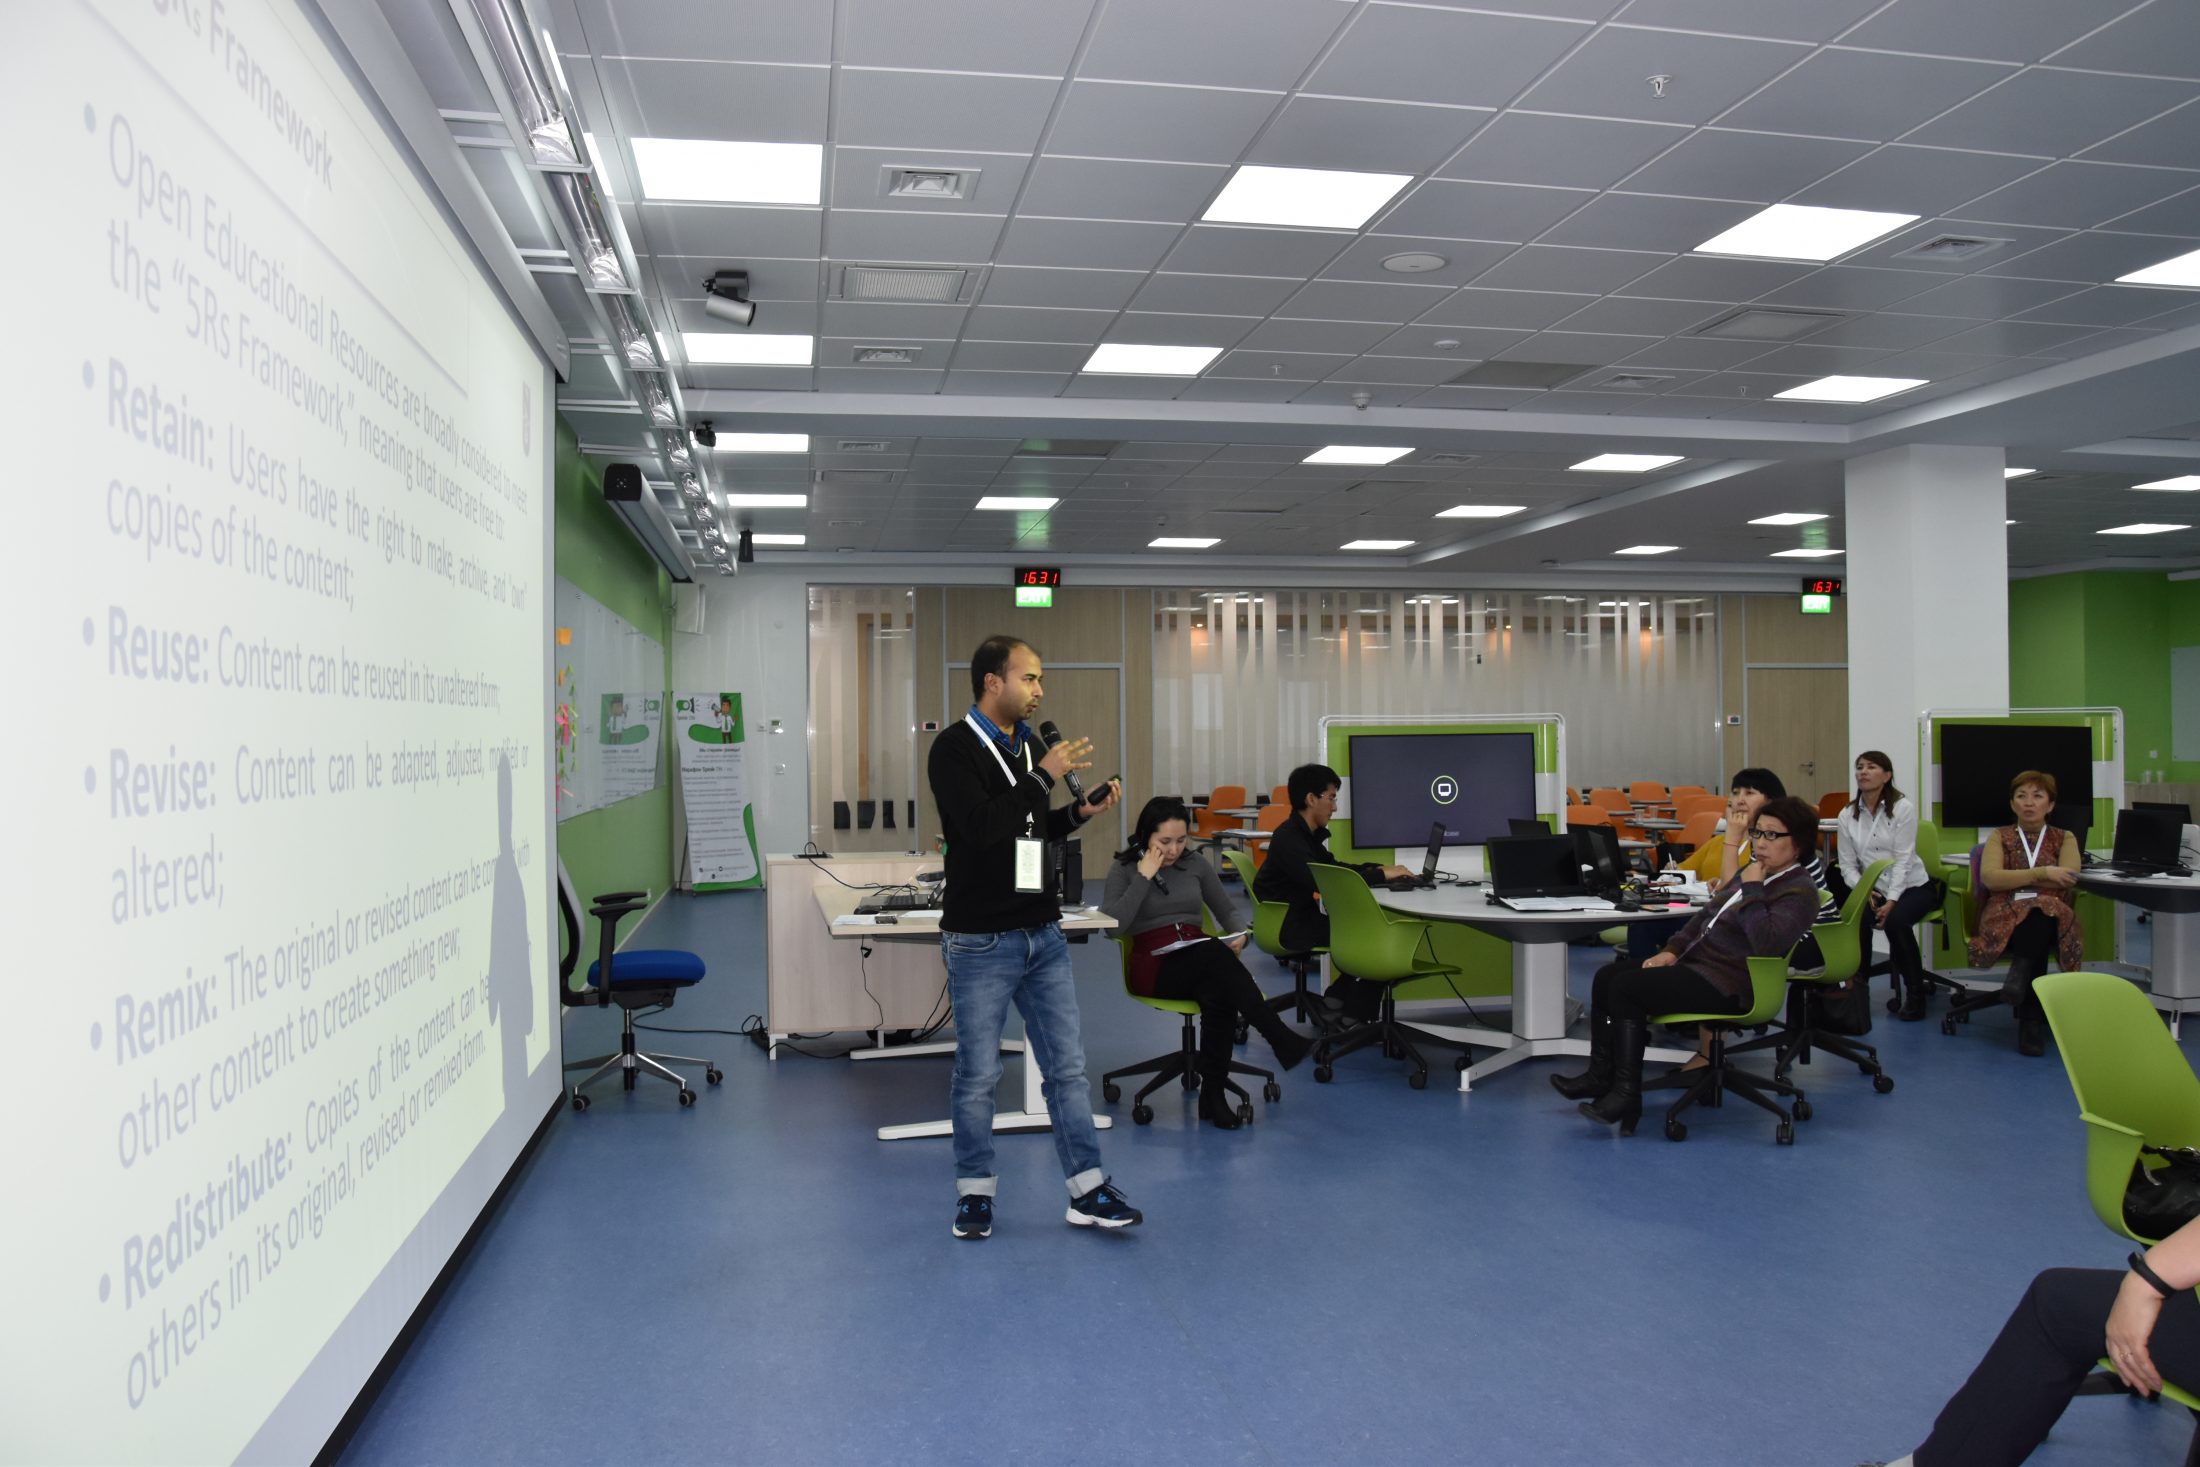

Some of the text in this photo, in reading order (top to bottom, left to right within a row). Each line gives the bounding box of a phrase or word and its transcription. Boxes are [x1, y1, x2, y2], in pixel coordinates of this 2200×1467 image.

[209, 0, 333, 192] Framework
[107, 218, 161, 315] the
[359, 414, 413, 492] meaning
[416, 448, 438, 498] that
[439, 473, 463, 515] users
[464, 492, 478, 524] are
[479, 492, 494, 535] free
[496, 508, 505, 541] to:
[109, 113, 192, 240] Open
[204, 194, 324, 348] Educational
[330, 308, 399, 411] Resources
[402, 384, 420, 428] are
[423, 391, 459, 468] broadly
[461, 437, 502, 494] considered
[503, 470, 510, 501] to
[107, 478, 354, 612] copies of the content;
[108, 357, 214, 472] Retain:
[229, 423, 287, 505] Users
[298, 456, 337, 529] have
[346, 486, 369, 543] the
[377, 505, 405, 564] right
[411, 524, 422, 566] to
[427, 536, 455, 588] make,
[459, 553, 490, 602] archive,
[493, 572, 506, 604] and
[108, 605, 209, 684] Reuse:
[217, 625, 302, 693] Content
[308, 653, 336, 696] can
[341, 644, 360, 699] be
[364, 656, 407, 701] reused
[410, 660, 420, 703] in
[423, 664, 435, 704] its
[437, 667, 479, 708] unaltered
[110, 744, 216, 819] Revise:
[235, 744, 316, 805] Content
[328, 752, 355, 794] can
[365, 739, 383, 789] be
[391, 738, 440, 794] adapted,
[445, 737, 485, 787] adjusted,
[521, 745, 528, 768] or
[112, 832, 224, 925] altered;
[115, 967, 217, 1066] Remix:
[224, 945, 267, 1011] The
[274, 909, 340, 991] original
[345, 913, 361, 955] or
[365, 881, 410, 945] revised
[413, 870, 452, 922] content
[453, 867, 469, 902] can
[470, 855, 481, 893] be
[118, 926, 460, 1170] other content to create something new;
[123, 1131, 293, 1311] Redistribute:
[305, 1077, 359, 1154] Copies
[368, 1045, 382, 1102] of
[390, 1033, 410, 1083] the
[417, 995, 455, 1059] content
[460, 985, 476, 1022] can
[127, 1029, 486, 1410] others in its original, revised or remixed form.
